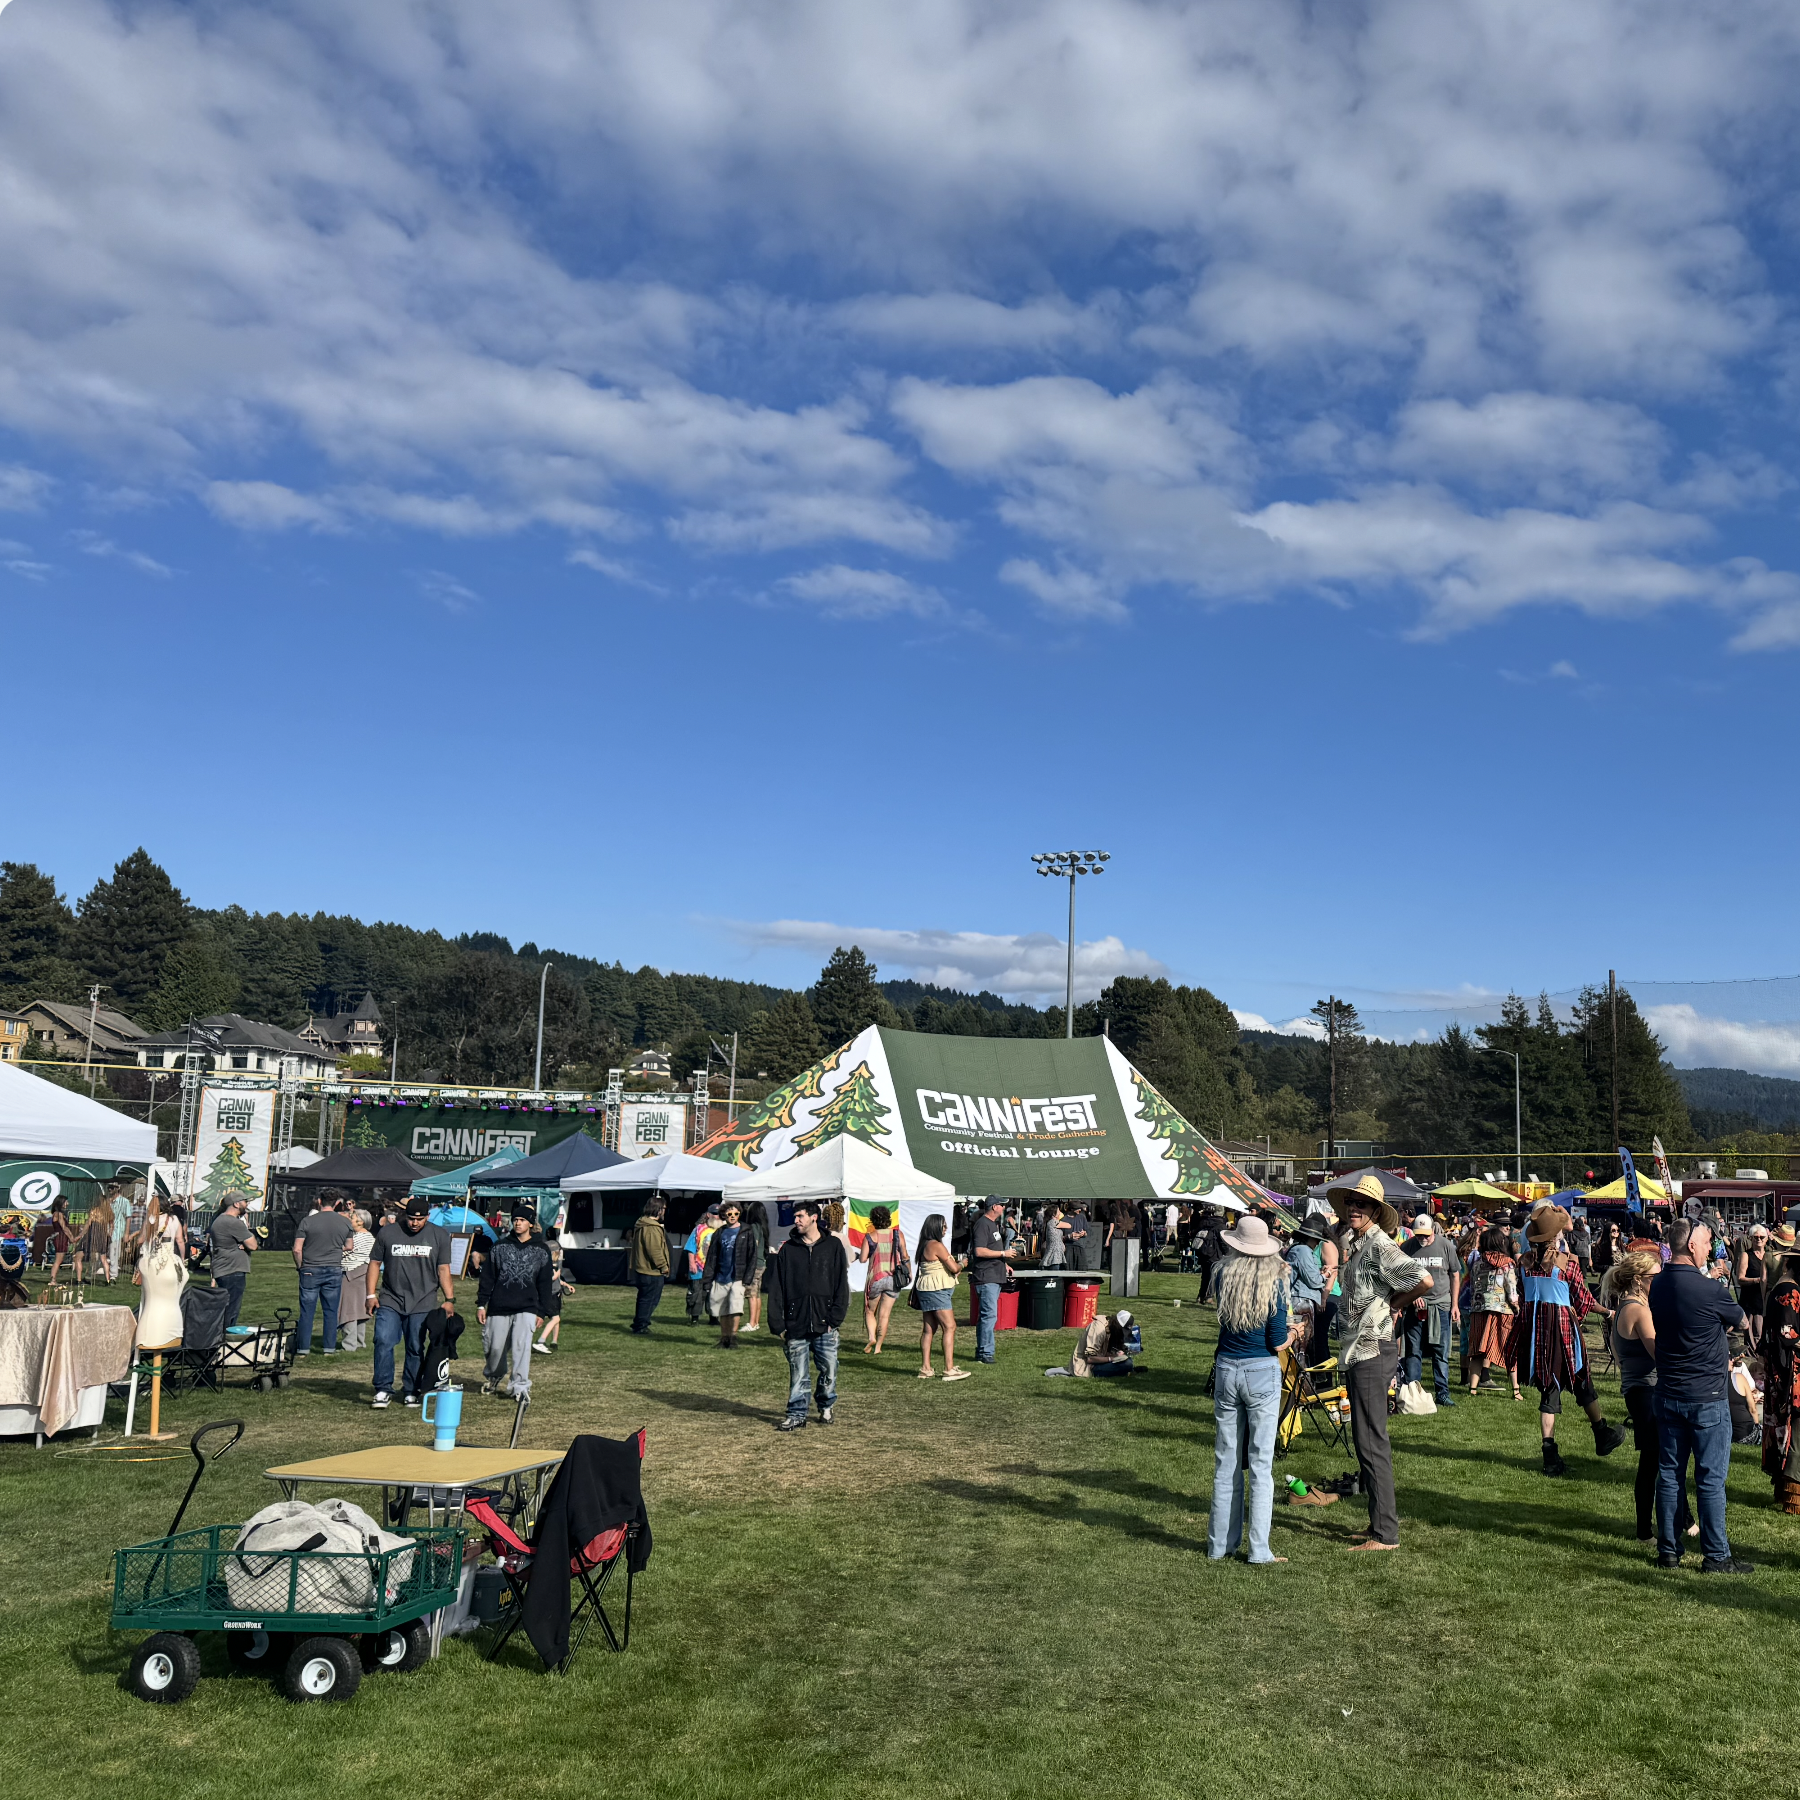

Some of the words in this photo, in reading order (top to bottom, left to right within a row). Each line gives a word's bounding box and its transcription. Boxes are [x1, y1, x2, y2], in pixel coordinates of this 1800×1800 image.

[923, 1123, 976, 1138] Community
[978, 1131, 1014, 1140] Festival
[1027, 1132, 1056, 1140] Trade
[1058, 1129, 1107, 1140] Gathering
[410, 1153, 447, 1162] Community
[448, 1154, 472, 1162] Festival
[940, 1140, 1021, 1158] Official
[1023, 1146, 1100, 1159] Lounge
[1624, 1163, 1636, 1202] BOBA
